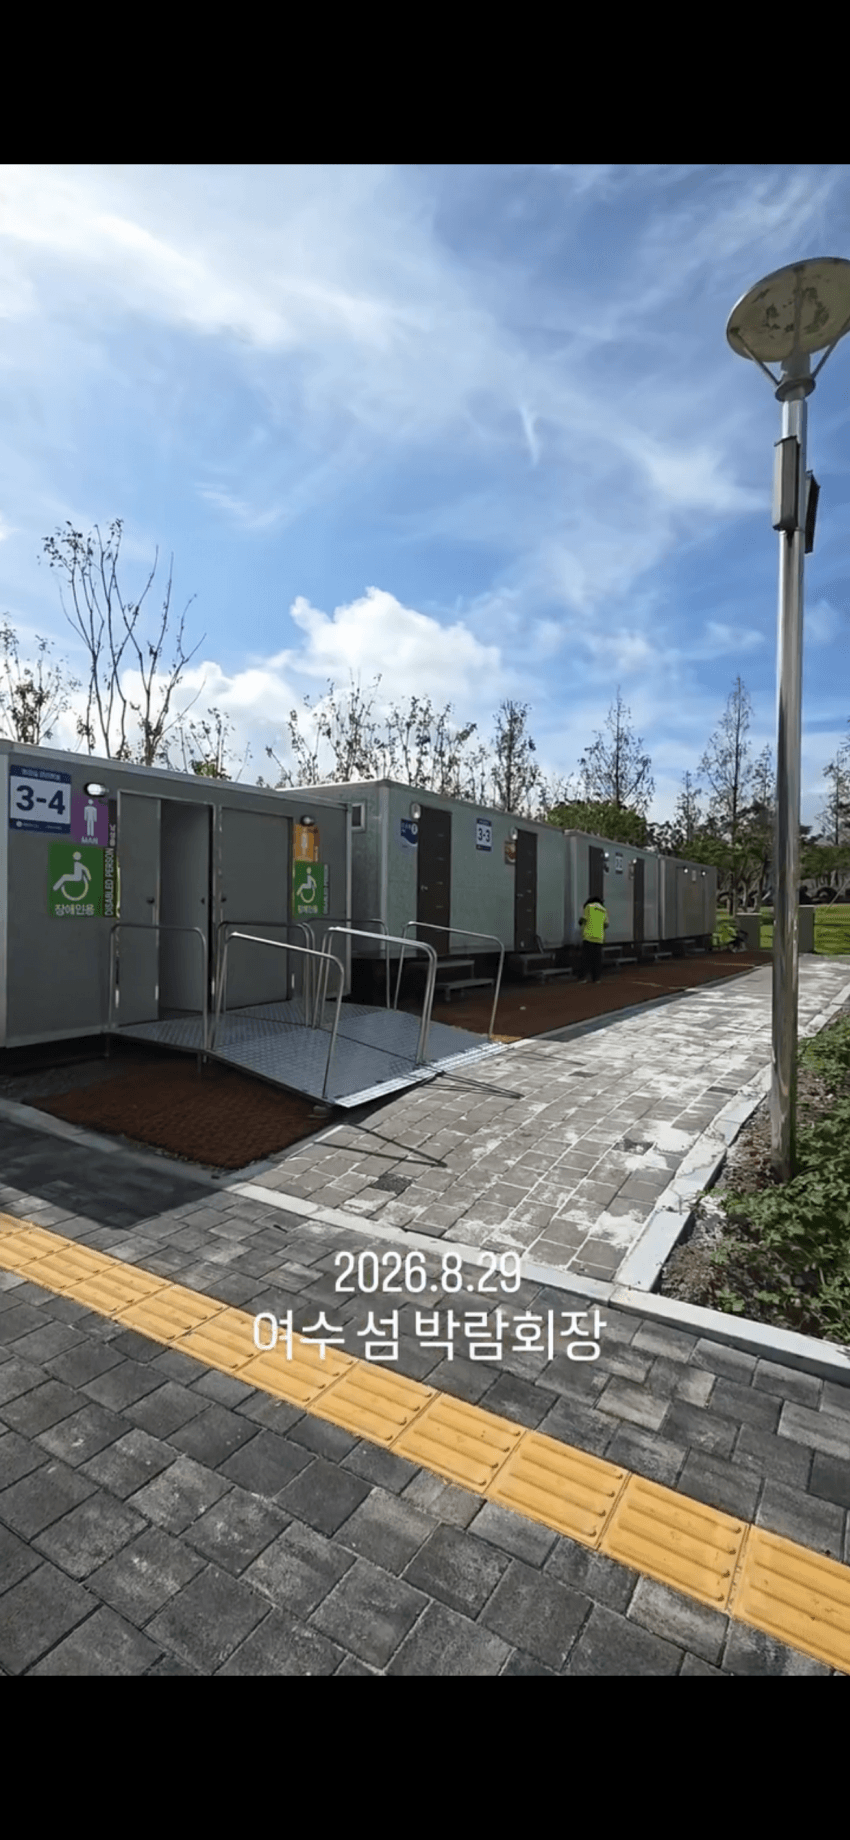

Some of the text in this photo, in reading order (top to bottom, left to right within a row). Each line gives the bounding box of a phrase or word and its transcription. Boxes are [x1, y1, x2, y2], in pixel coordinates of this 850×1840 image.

[16, 785, 65, 815] 3-4
[478, 827, 491, 843] 3-3
[104, 848, 114, 877] PERSON
[54, 904, 95, 916] 장애인용
[104, 879, 114, 916] DISABLED
